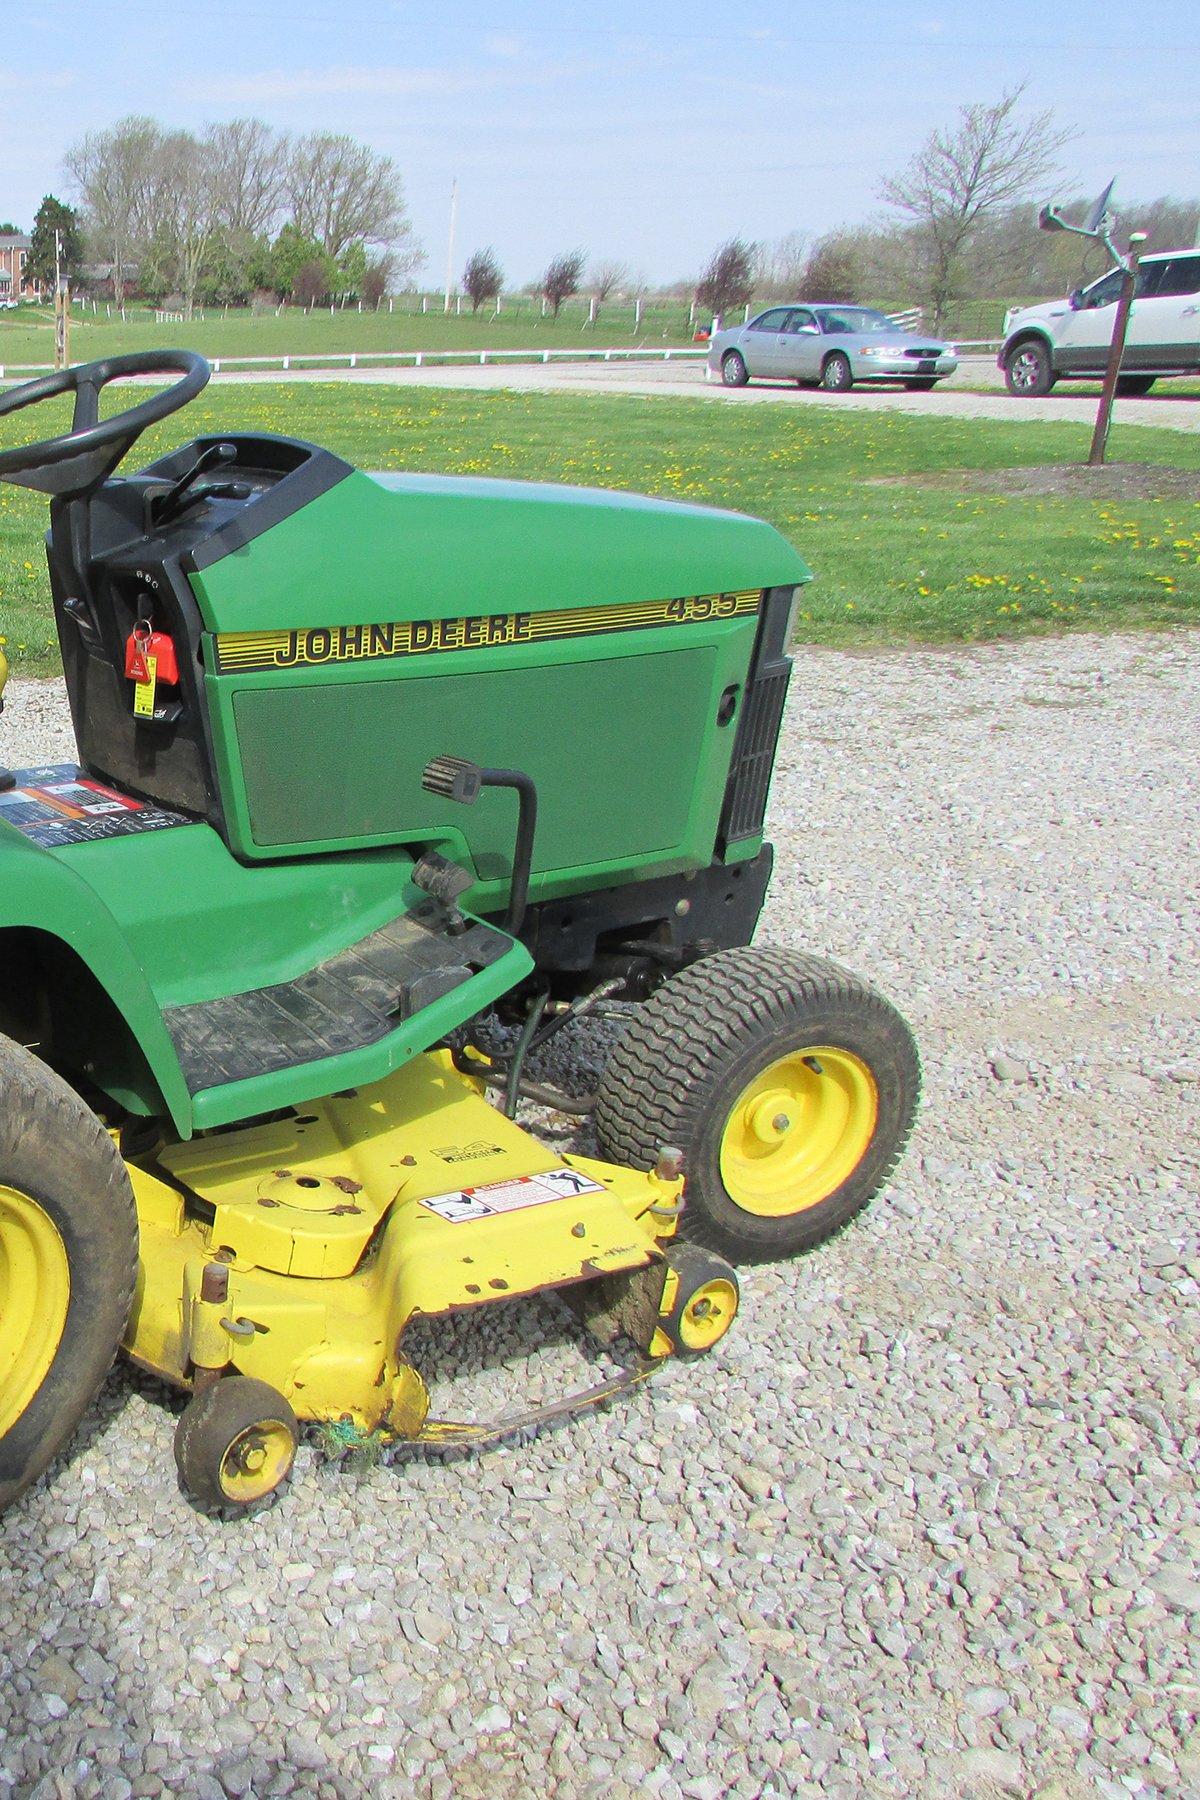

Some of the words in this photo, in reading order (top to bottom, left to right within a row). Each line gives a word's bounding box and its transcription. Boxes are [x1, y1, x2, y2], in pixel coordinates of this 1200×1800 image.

[664, 592, 738, 622] 455
[274, 622, 395, 667] JOHN
[409, 611, 534, 652] DEERE
